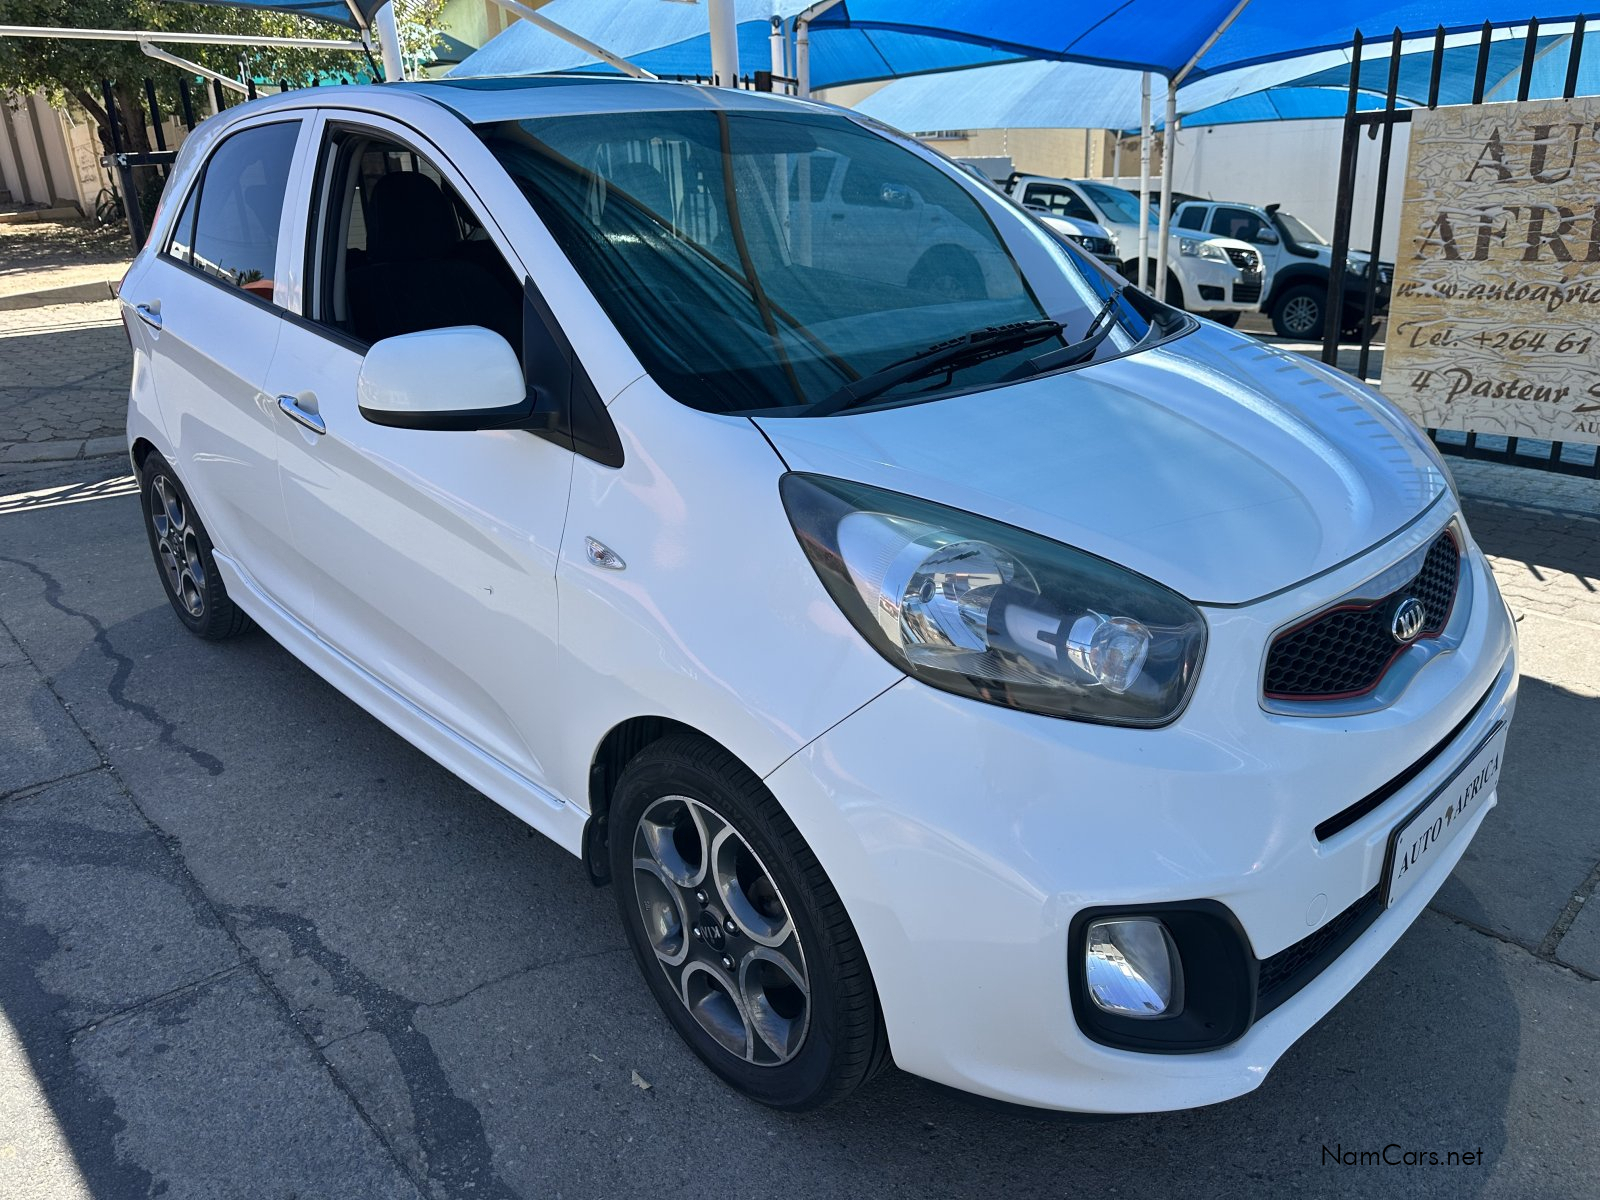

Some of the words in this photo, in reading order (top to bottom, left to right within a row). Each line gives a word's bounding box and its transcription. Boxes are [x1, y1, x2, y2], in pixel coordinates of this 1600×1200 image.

[1465, 122, 1600, 184] AU
[1397, 321, 1458, 348] Tel.
[1473, 330, 1548, 352] +264
[1555, 332, 1592, 354] 61
[1411, 371, 1433, 392] 4
[1443, 368, 1570, 404] Pasteur
[1398, 817, 1442, 879] AUTO
[1453, 752, 1499, 819] AFRICA
